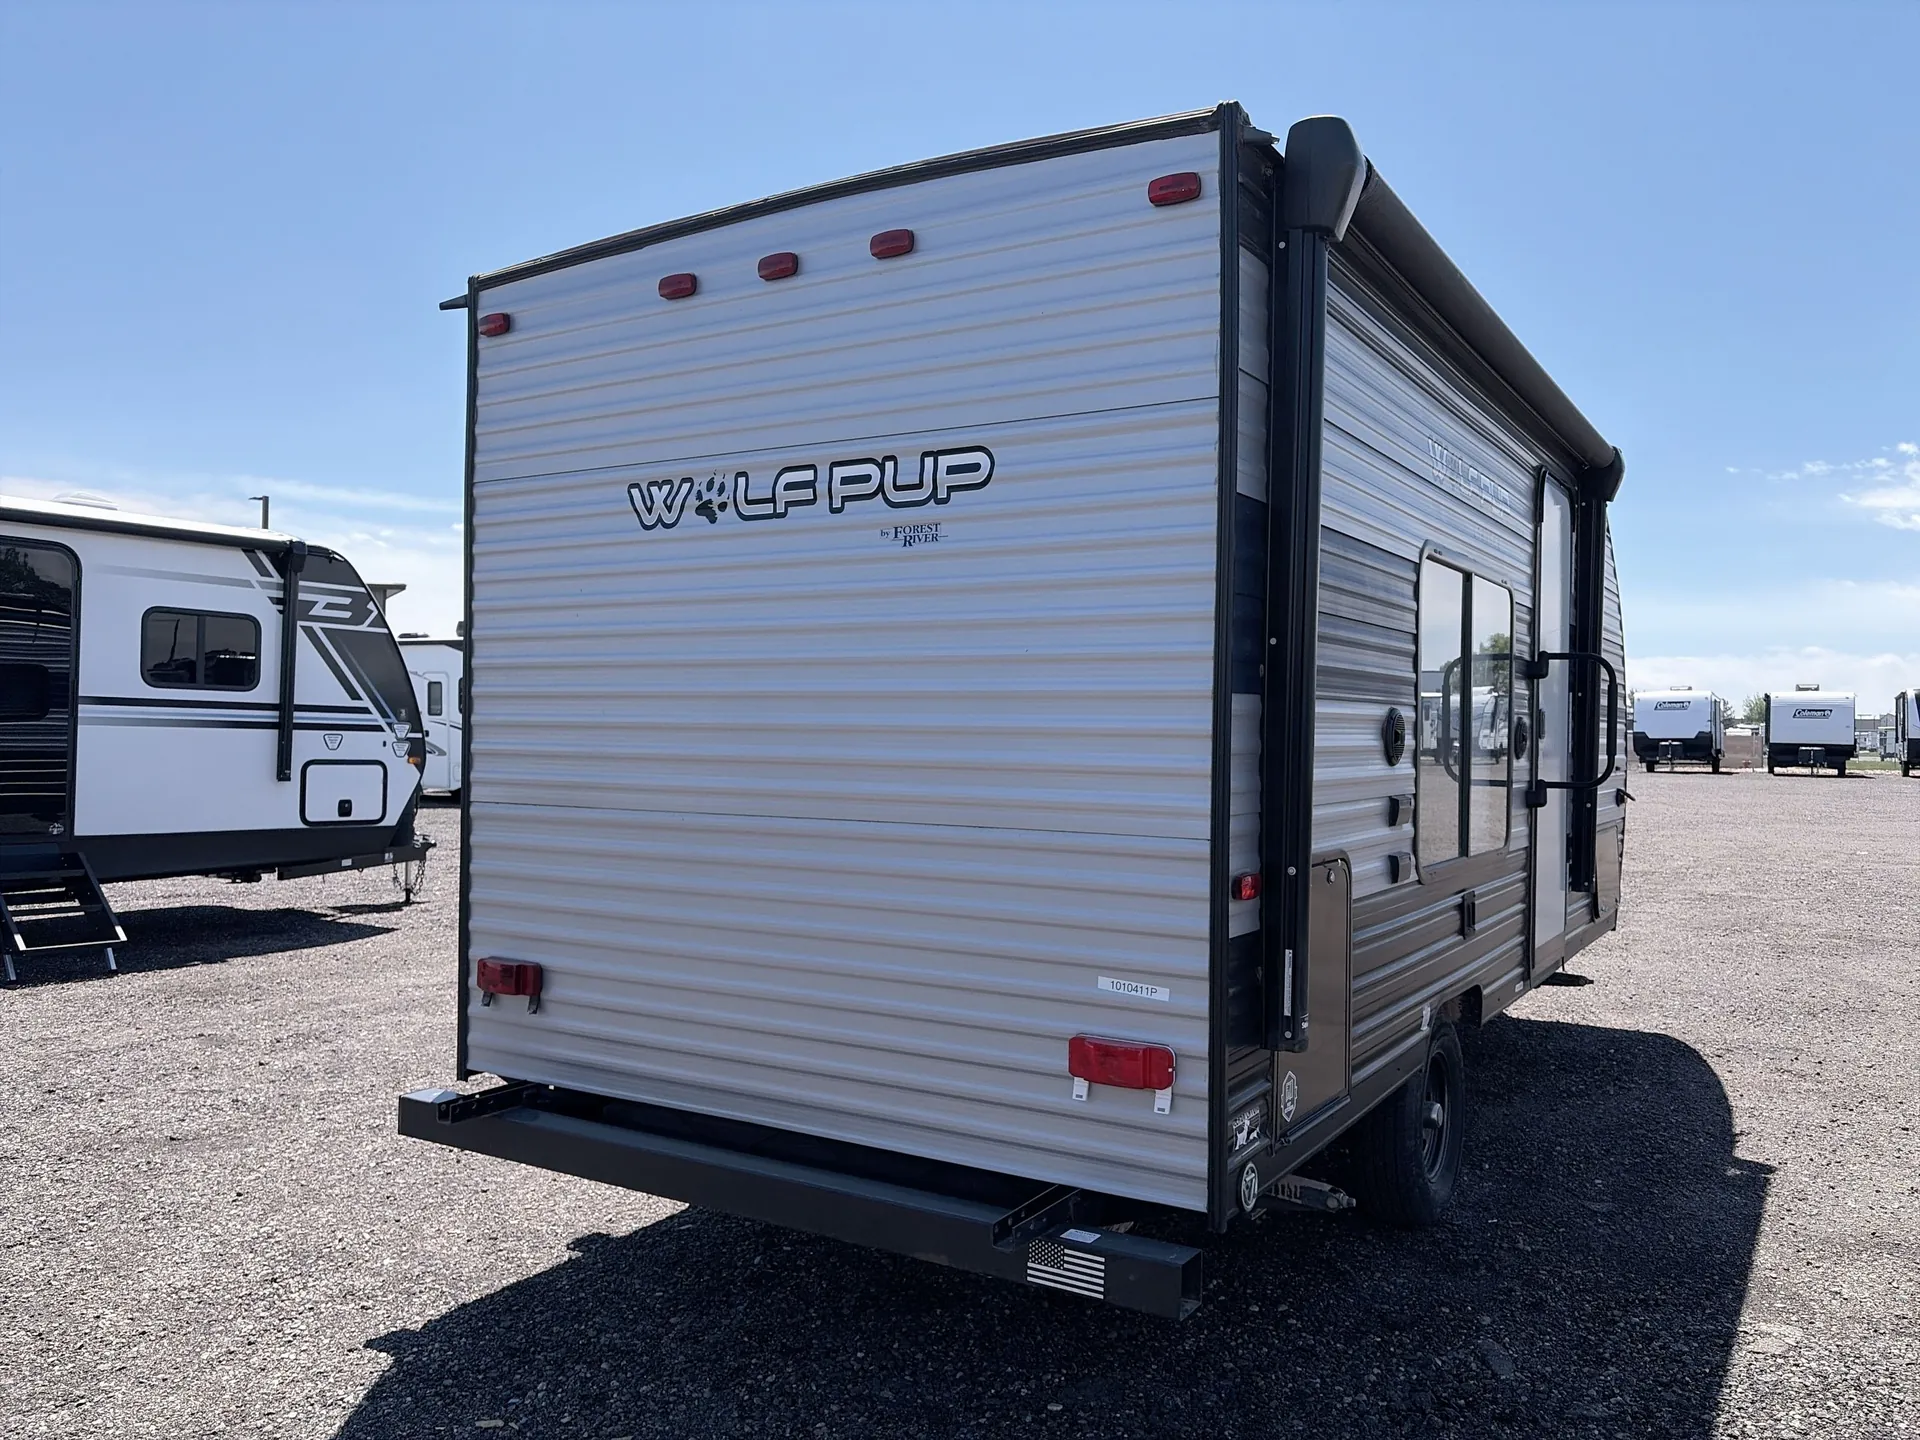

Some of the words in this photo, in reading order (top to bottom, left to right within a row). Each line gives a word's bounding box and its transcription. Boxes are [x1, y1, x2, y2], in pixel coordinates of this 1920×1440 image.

[829, 445, 996, 514] PUP
[880, 529, 891, 538] by
[893, 522, 941, 539] FOREST
[902, 533, 939, 547] RIVER
[1656, 700, 1684, 710] Coleman
[1795, 708, 1825, 718] Coleman
[1111, 980, 1158, 997] 1010411P
